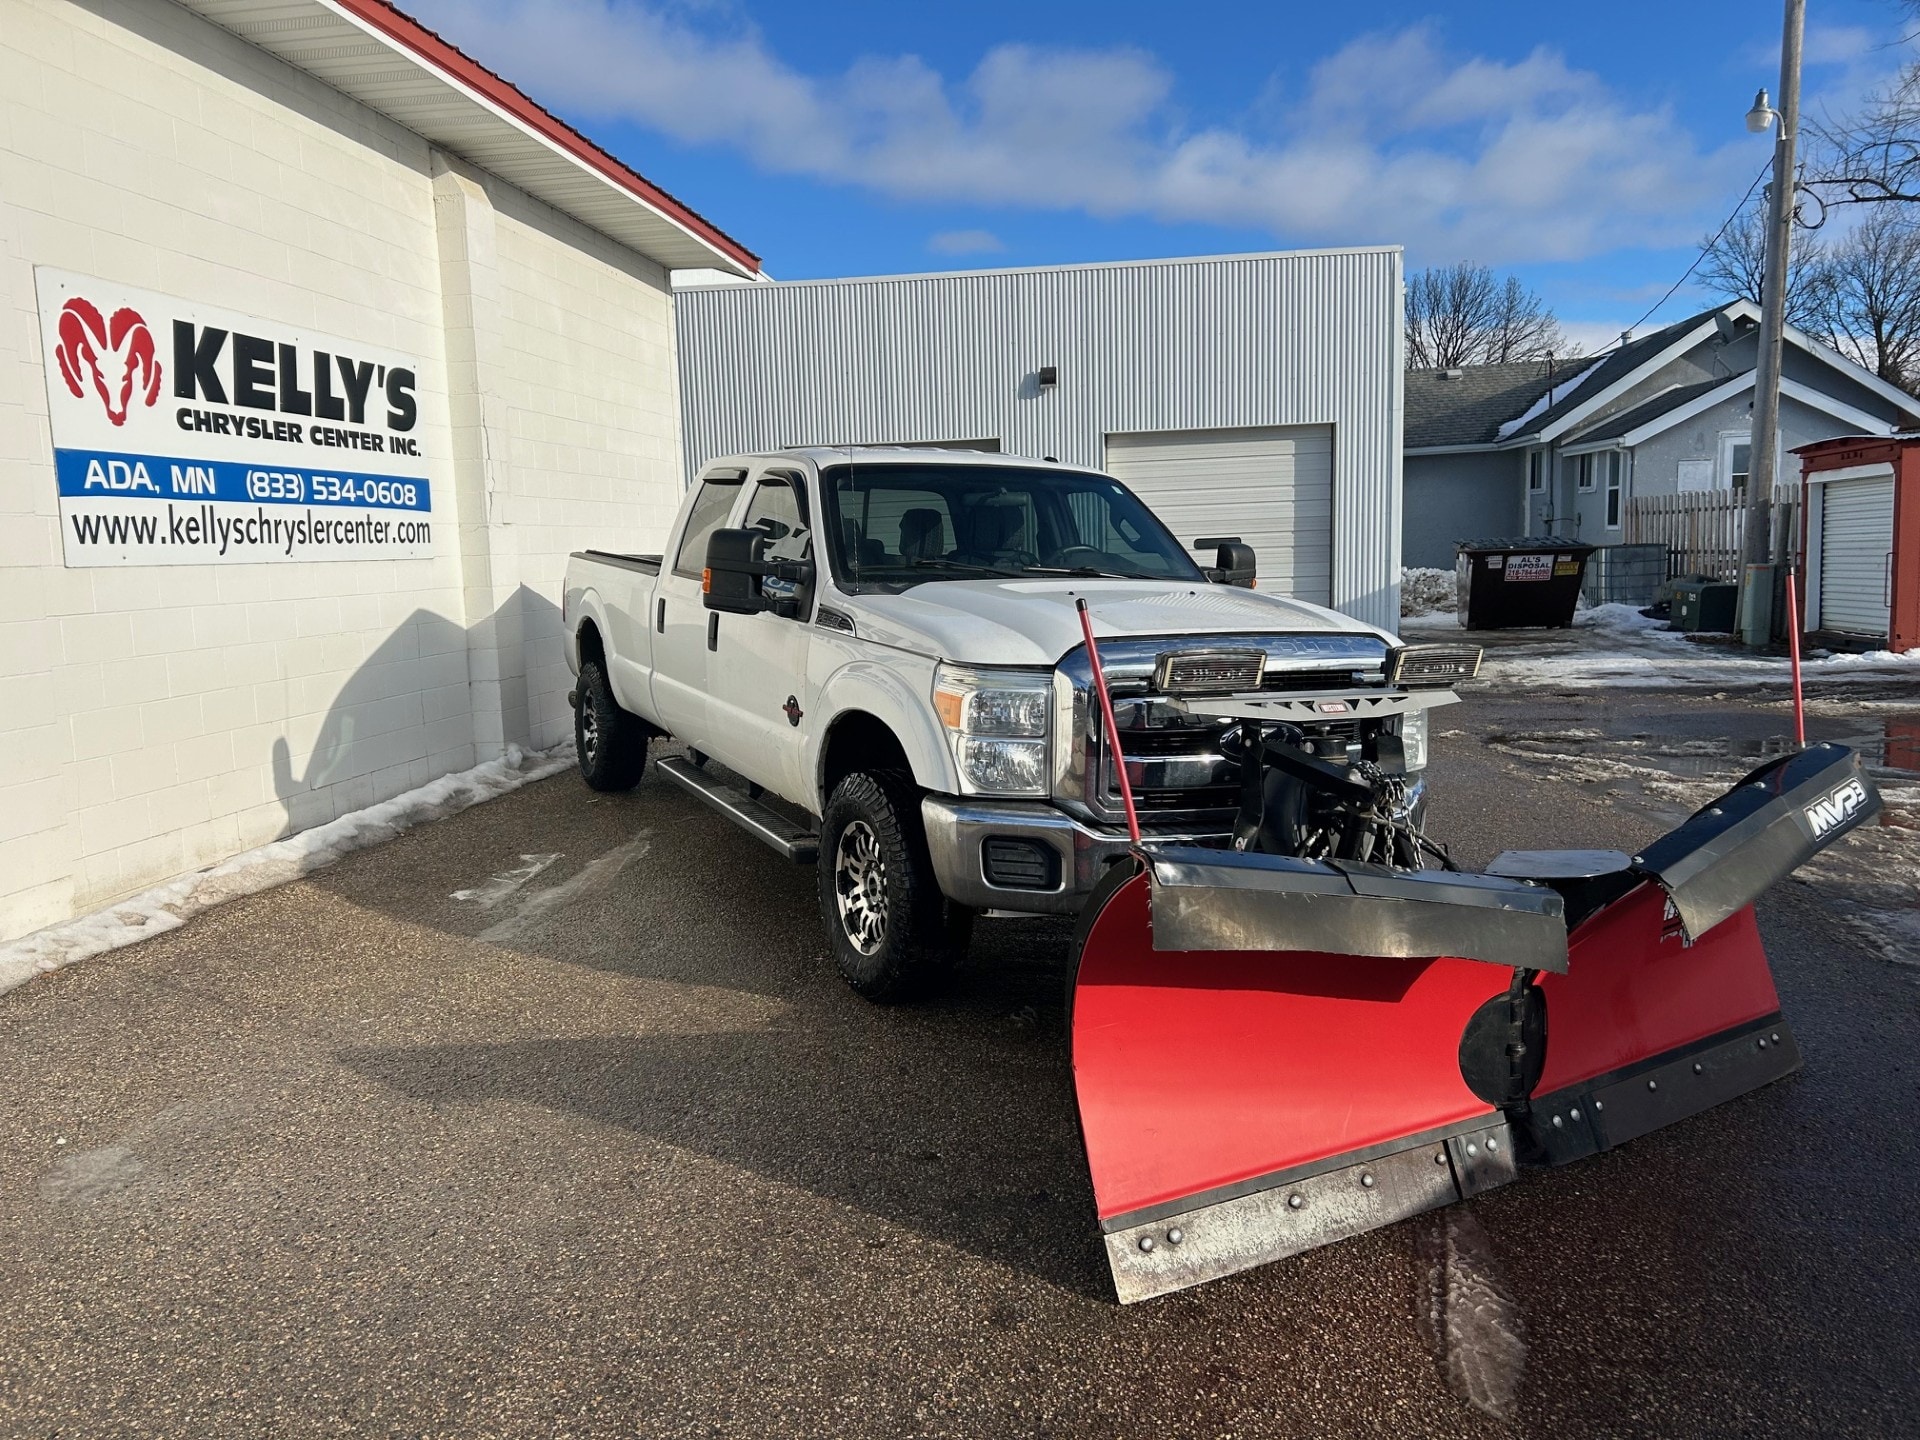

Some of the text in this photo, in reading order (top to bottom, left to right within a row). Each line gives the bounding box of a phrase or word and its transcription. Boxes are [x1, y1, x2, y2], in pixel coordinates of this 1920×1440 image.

[172, 318, 418, 432] KELLY'S
[176, 408, 422, 457] CHRYSLER CENTER INC.
[84, 460, 417, 506] ADA, MN (833) 534-0608
[71, 504, 431, 556] www.kellyschryslercenter.com
